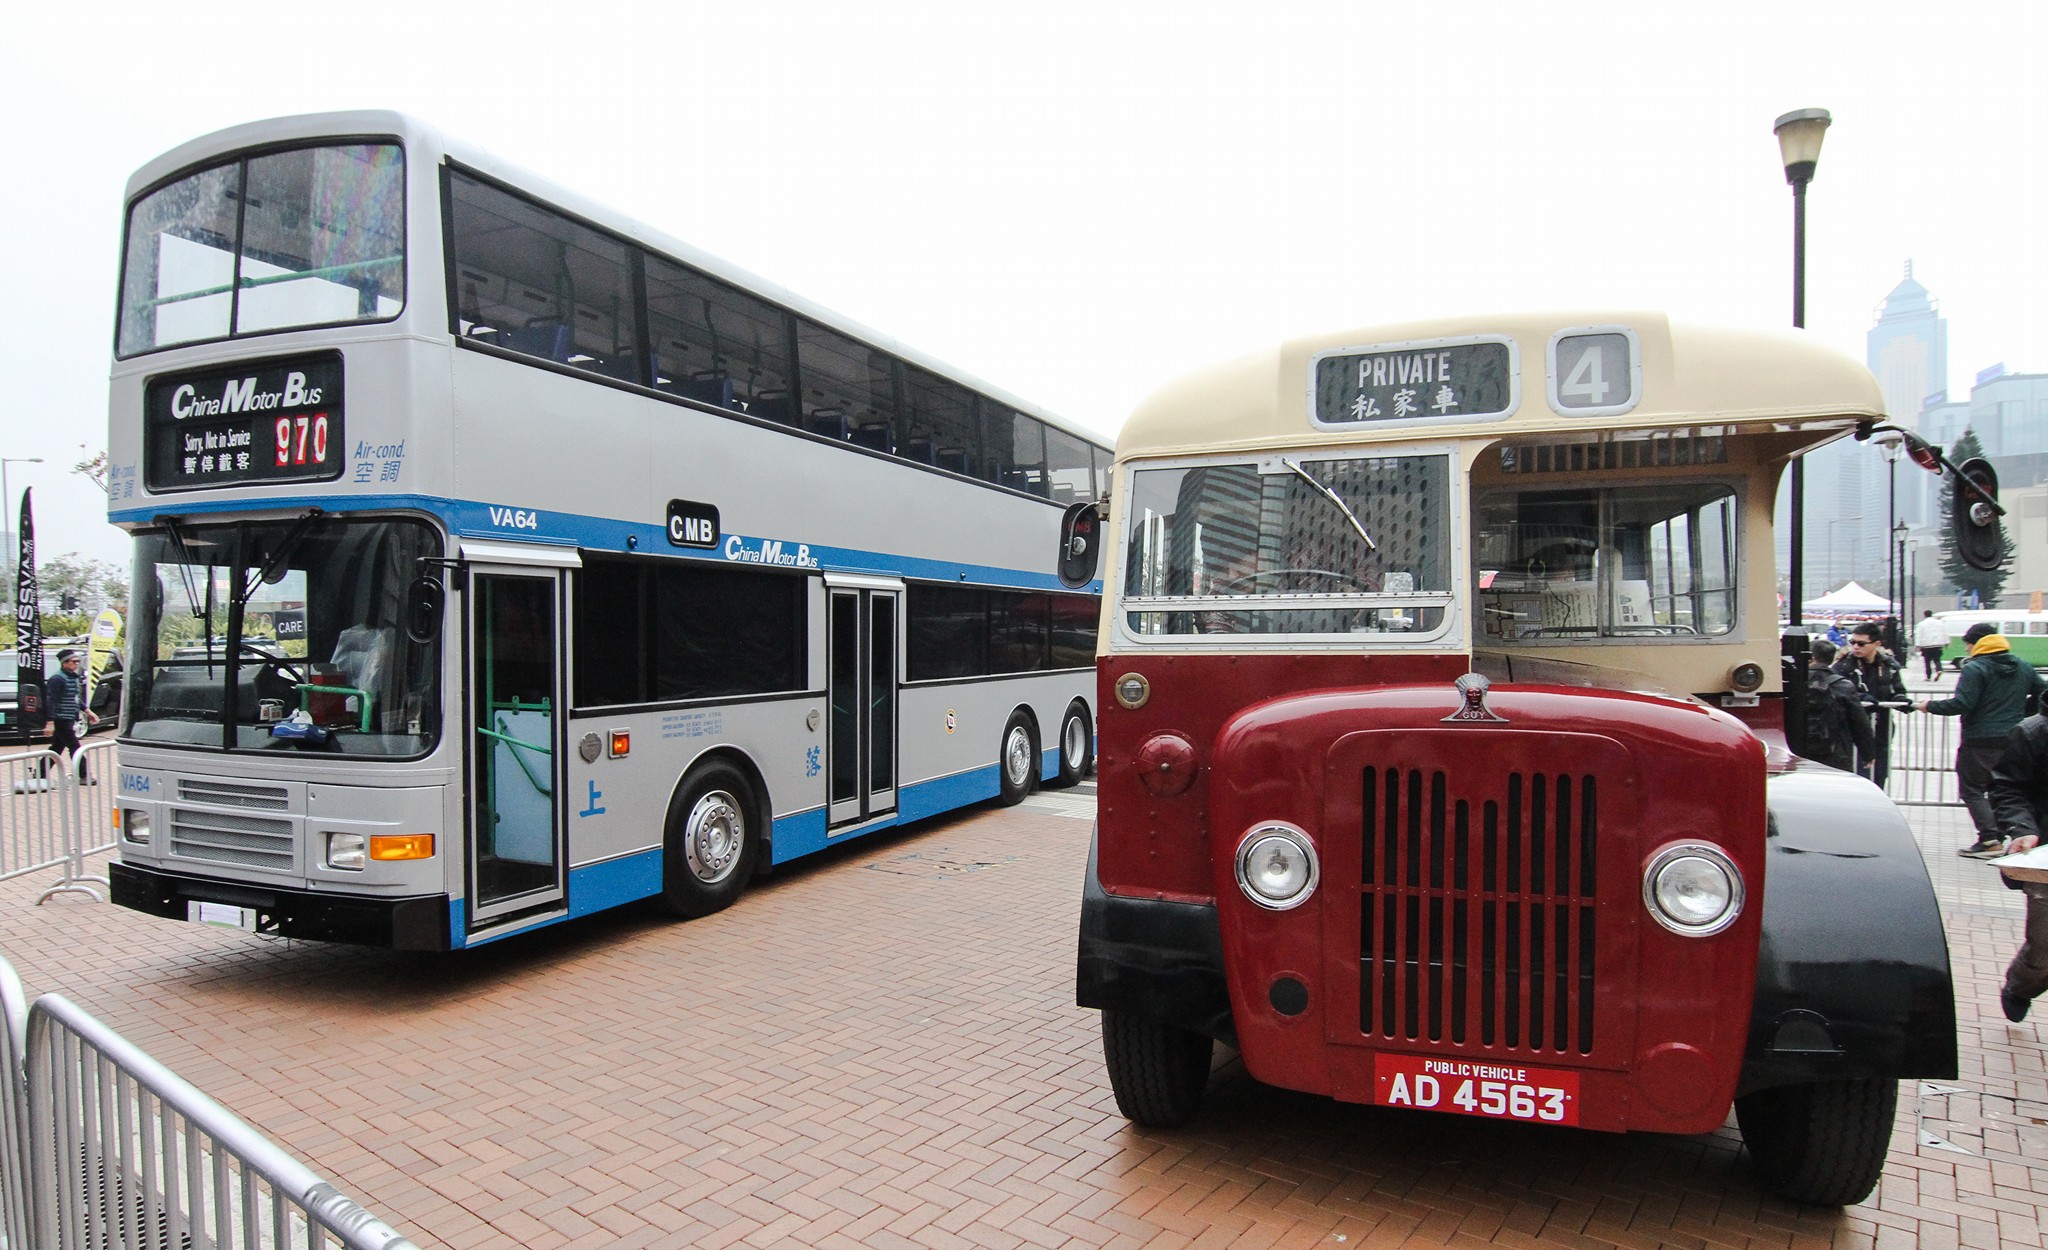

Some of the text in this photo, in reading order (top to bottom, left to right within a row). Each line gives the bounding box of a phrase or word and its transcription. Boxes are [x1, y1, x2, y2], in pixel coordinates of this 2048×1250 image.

[1358, 352, 1451, 388] PRIVATE
[1561, 346, 1609, 403] 4
[171, 371, 322, 419] China Motor Bus
[1350, 385, 1459, 420] 私家車
[205, 431, 218, 450] Not
[219, 432, 226, 448] in
[227, 428, 250, 448] Service
[276, 416, 328, 463] 970
[354, 439, 405, 459] Air-cond.
[353, 460, 401, 483] 空調
[489, 506, 538, 530] VA64
[670, 514, 714, 543] CMB
[724, 535, 818, 568] China Motor Bus
[278, 620, 303, 634] CARE
[1462, 711, 1486, 719] GUY
[806, 745, 822, 778] 落
[121, 773, 150, 792] VA64
[579, 780, 606, 817] 上
[1425, 1060, 1526, 1082] PUBLIC VEHICLE
[1388, 1072, 1565, 1121] AD 4563
